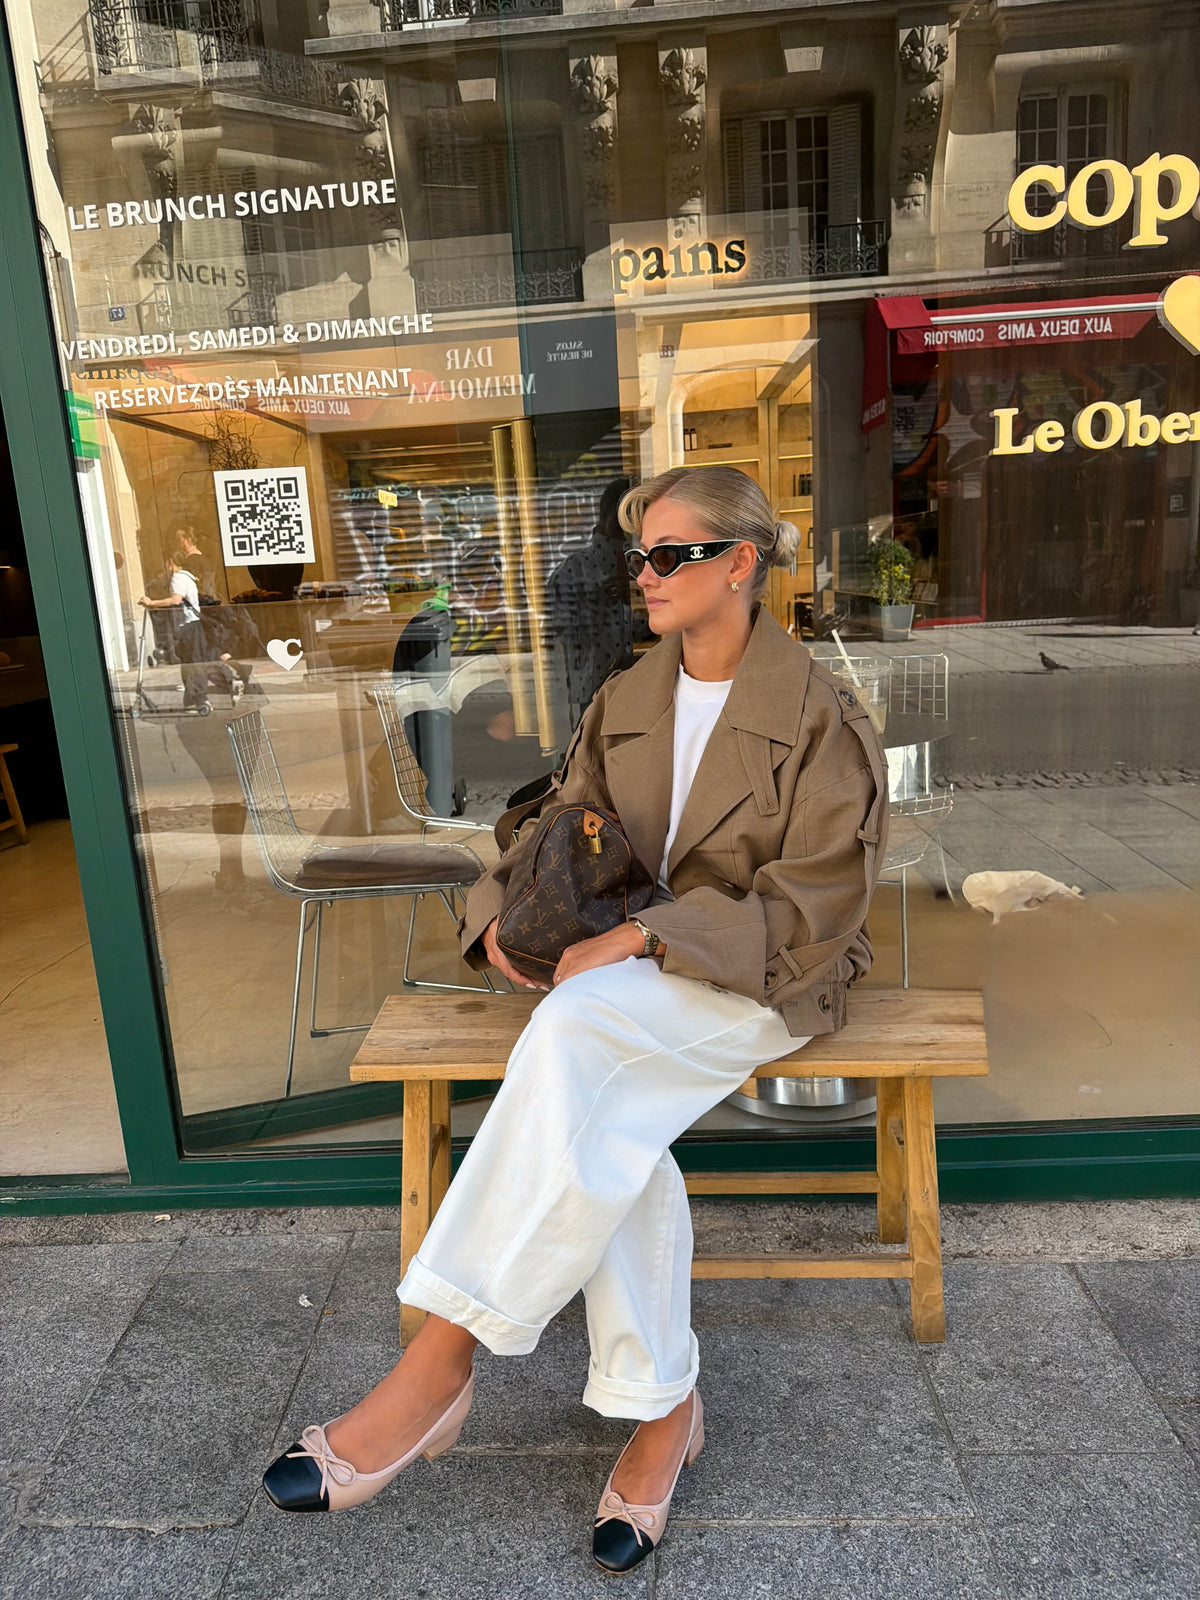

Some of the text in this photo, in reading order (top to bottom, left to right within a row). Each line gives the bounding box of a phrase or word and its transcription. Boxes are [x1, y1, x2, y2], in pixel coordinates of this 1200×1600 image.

[67, 178, 396, 230] LE BRUNCH SIGNATURE
[611, 229, 746, 296] pains
[61, 313, 434, 360] VENDREDI, SAMEDI & DIMANCHE
[93, 367, 412, 410] RESERVEZ DÈS MAINTENANT
[993, 407, 1065, 455] Le
